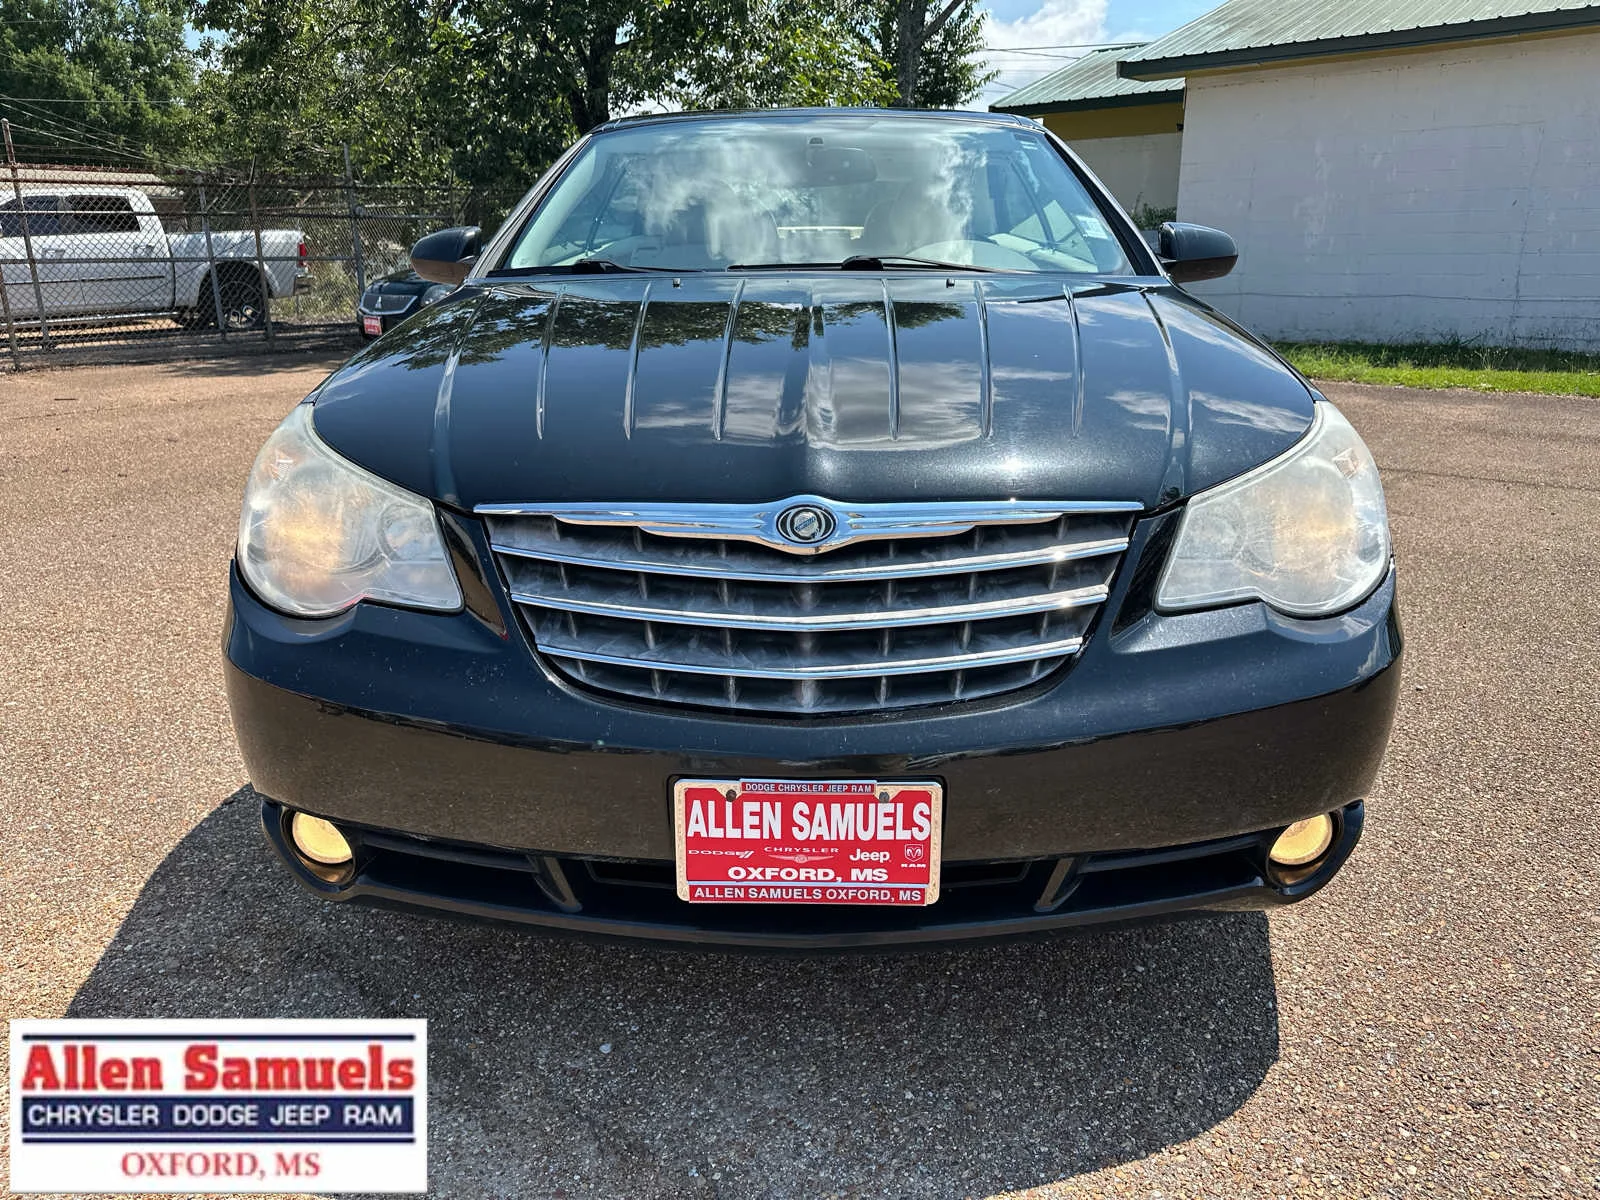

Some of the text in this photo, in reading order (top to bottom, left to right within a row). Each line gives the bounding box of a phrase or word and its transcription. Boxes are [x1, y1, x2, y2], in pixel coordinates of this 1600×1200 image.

[745, 783, 775, 792] DODGE
[778, 783, 824, 792] CHRYSLER
[851, 785, 872, 793] RAM
[687, 799, 931, 841] ALLEN SAMUELS
[688, 849, 747, 858] DODGE
[849, 848, 891, 863] Jeep
[727, 866, 889, 882] OXFORD, MS
[694, 887, 921, 903] ALLEN SAMUELS OXFORD, MS
